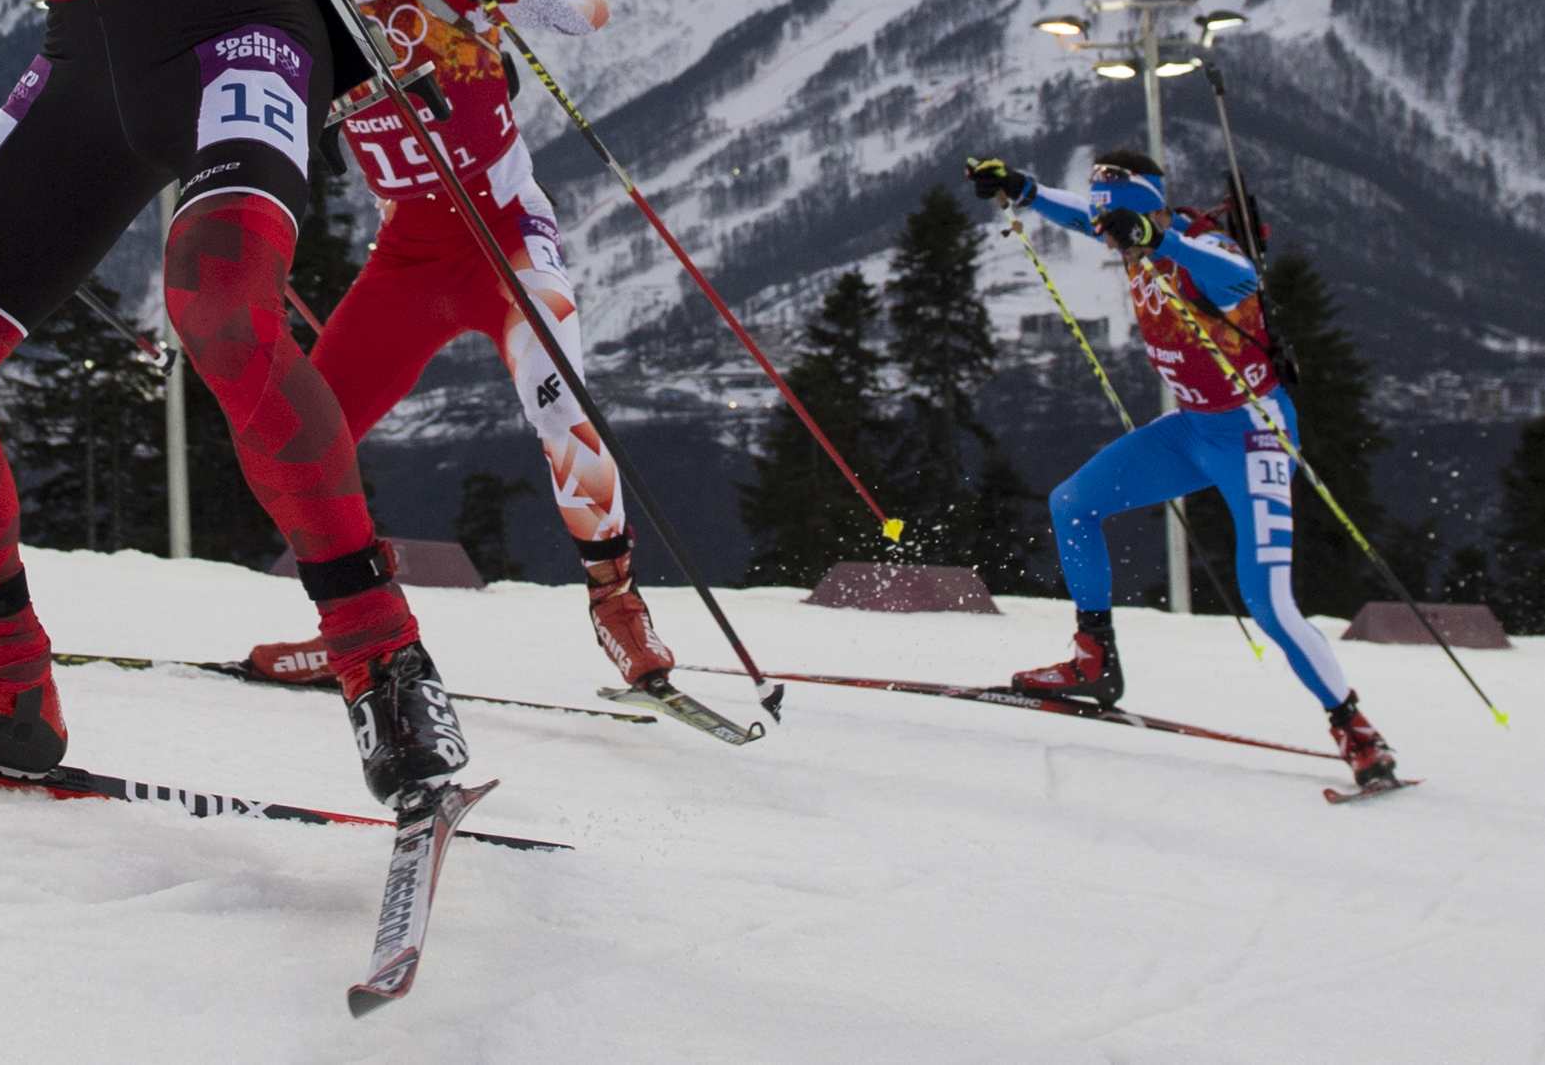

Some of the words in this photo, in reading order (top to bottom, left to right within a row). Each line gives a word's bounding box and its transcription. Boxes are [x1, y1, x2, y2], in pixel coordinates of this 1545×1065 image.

[220, 82, 294, 143] 12
[345, 114, 403, 134] SOCHI
[1259, 459, 1287, 486] 16
[976, 691, 1043, 709] ATOMIC
